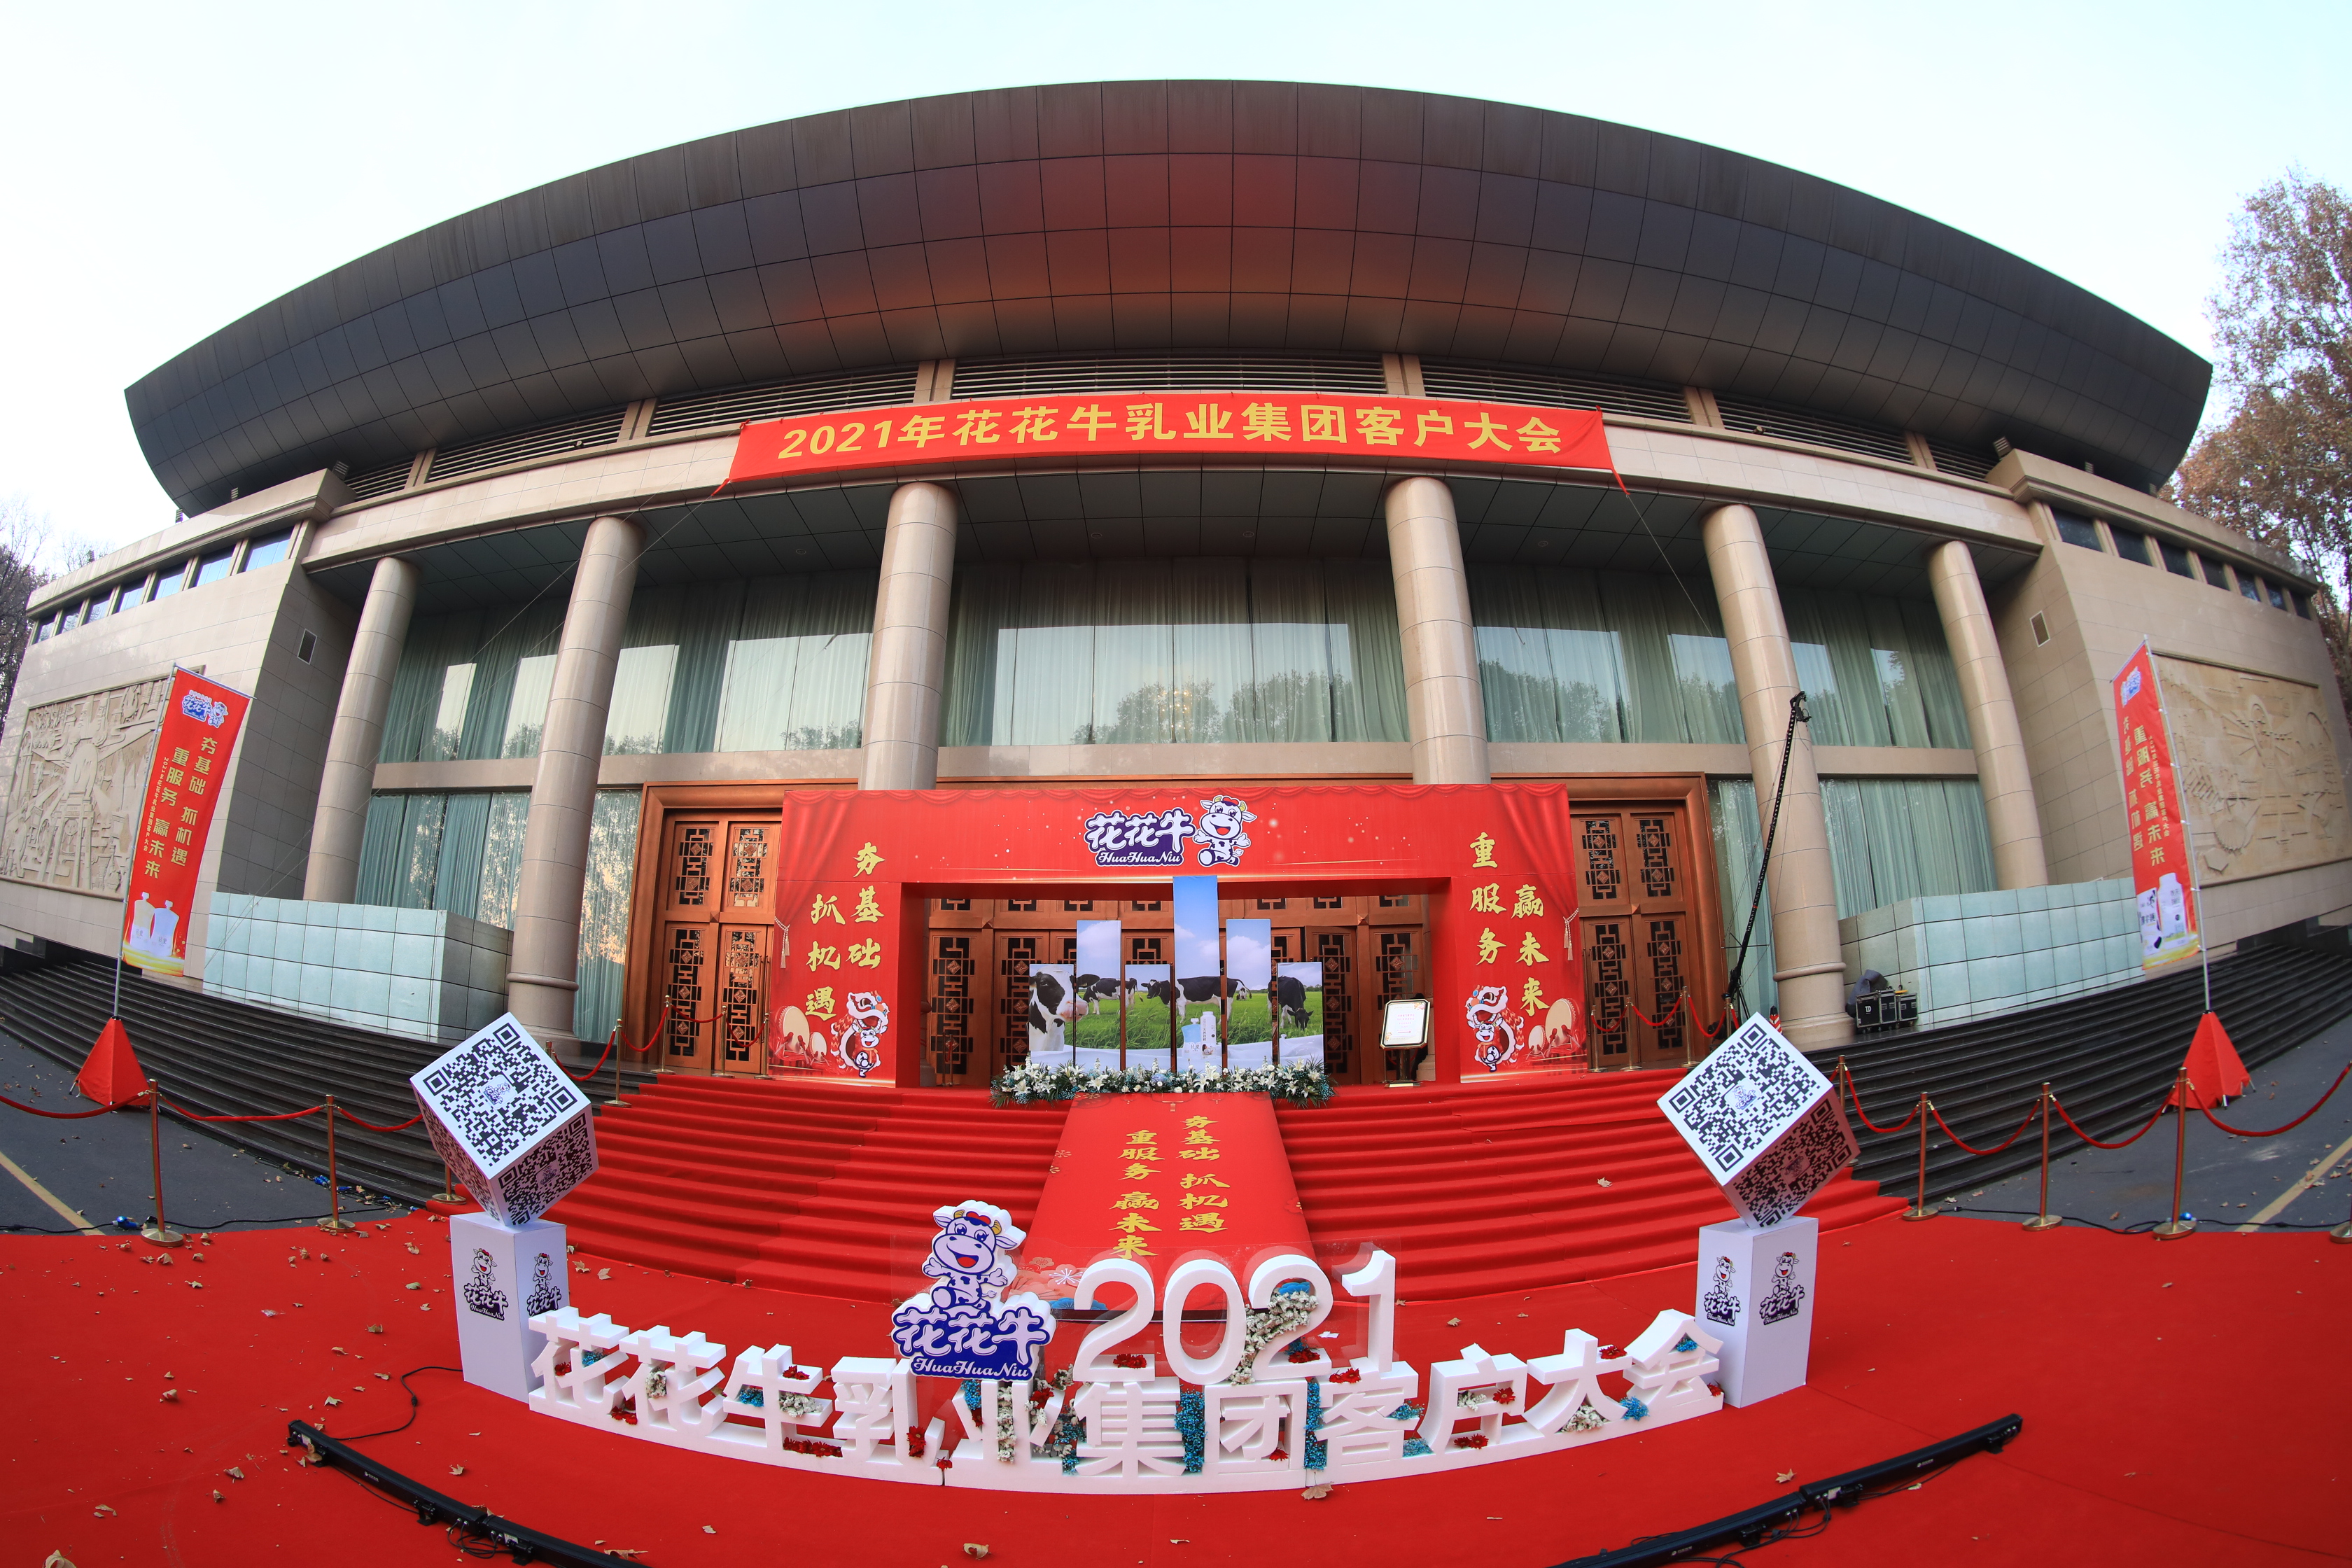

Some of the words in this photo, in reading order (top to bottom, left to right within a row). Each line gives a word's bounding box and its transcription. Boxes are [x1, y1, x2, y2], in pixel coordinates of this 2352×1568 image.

[778, 402, 1562, 459] 2021年花花牛乳业集团客户大会
[161, 747, 190, 806] 重服务
[189, 737, 217, 795] 夯基础
[144, 818, 171, 879] 赢未来
[171, 806, 198, 867] 抓机遇
[1086, 808, 1196, 853] 花花牛
[846, 842, 886, 969] 夯基础
[1469, 832, 1507, 966] 重服务
[805, 894, 846, 1021] 抓机遇
[1511, 884, 1550, 1016] 赢未来
[1118, 1129, 1166, 1180] 重服务
[1176, 1115, 1221, 1161] 夯基础
[1109, 1191, 1163, 1259] 赢未来
[1177, 1173, 1231, 1233] 抓机遇
[463, 1282, 509, 1316] 花花牛
[526, 1286, 562, 1316] 花花牛
[1074, 1248, 1396, 1385] 2021
[1704, 1292, 1741, 1322] 花花牛
[1759, 1284, 1805, 1319] 花花牛
[894, 1306, 1049, 1366] 花花牛
[528, 1306, 1724, 1476] 花花牛乳业集团客户大会
